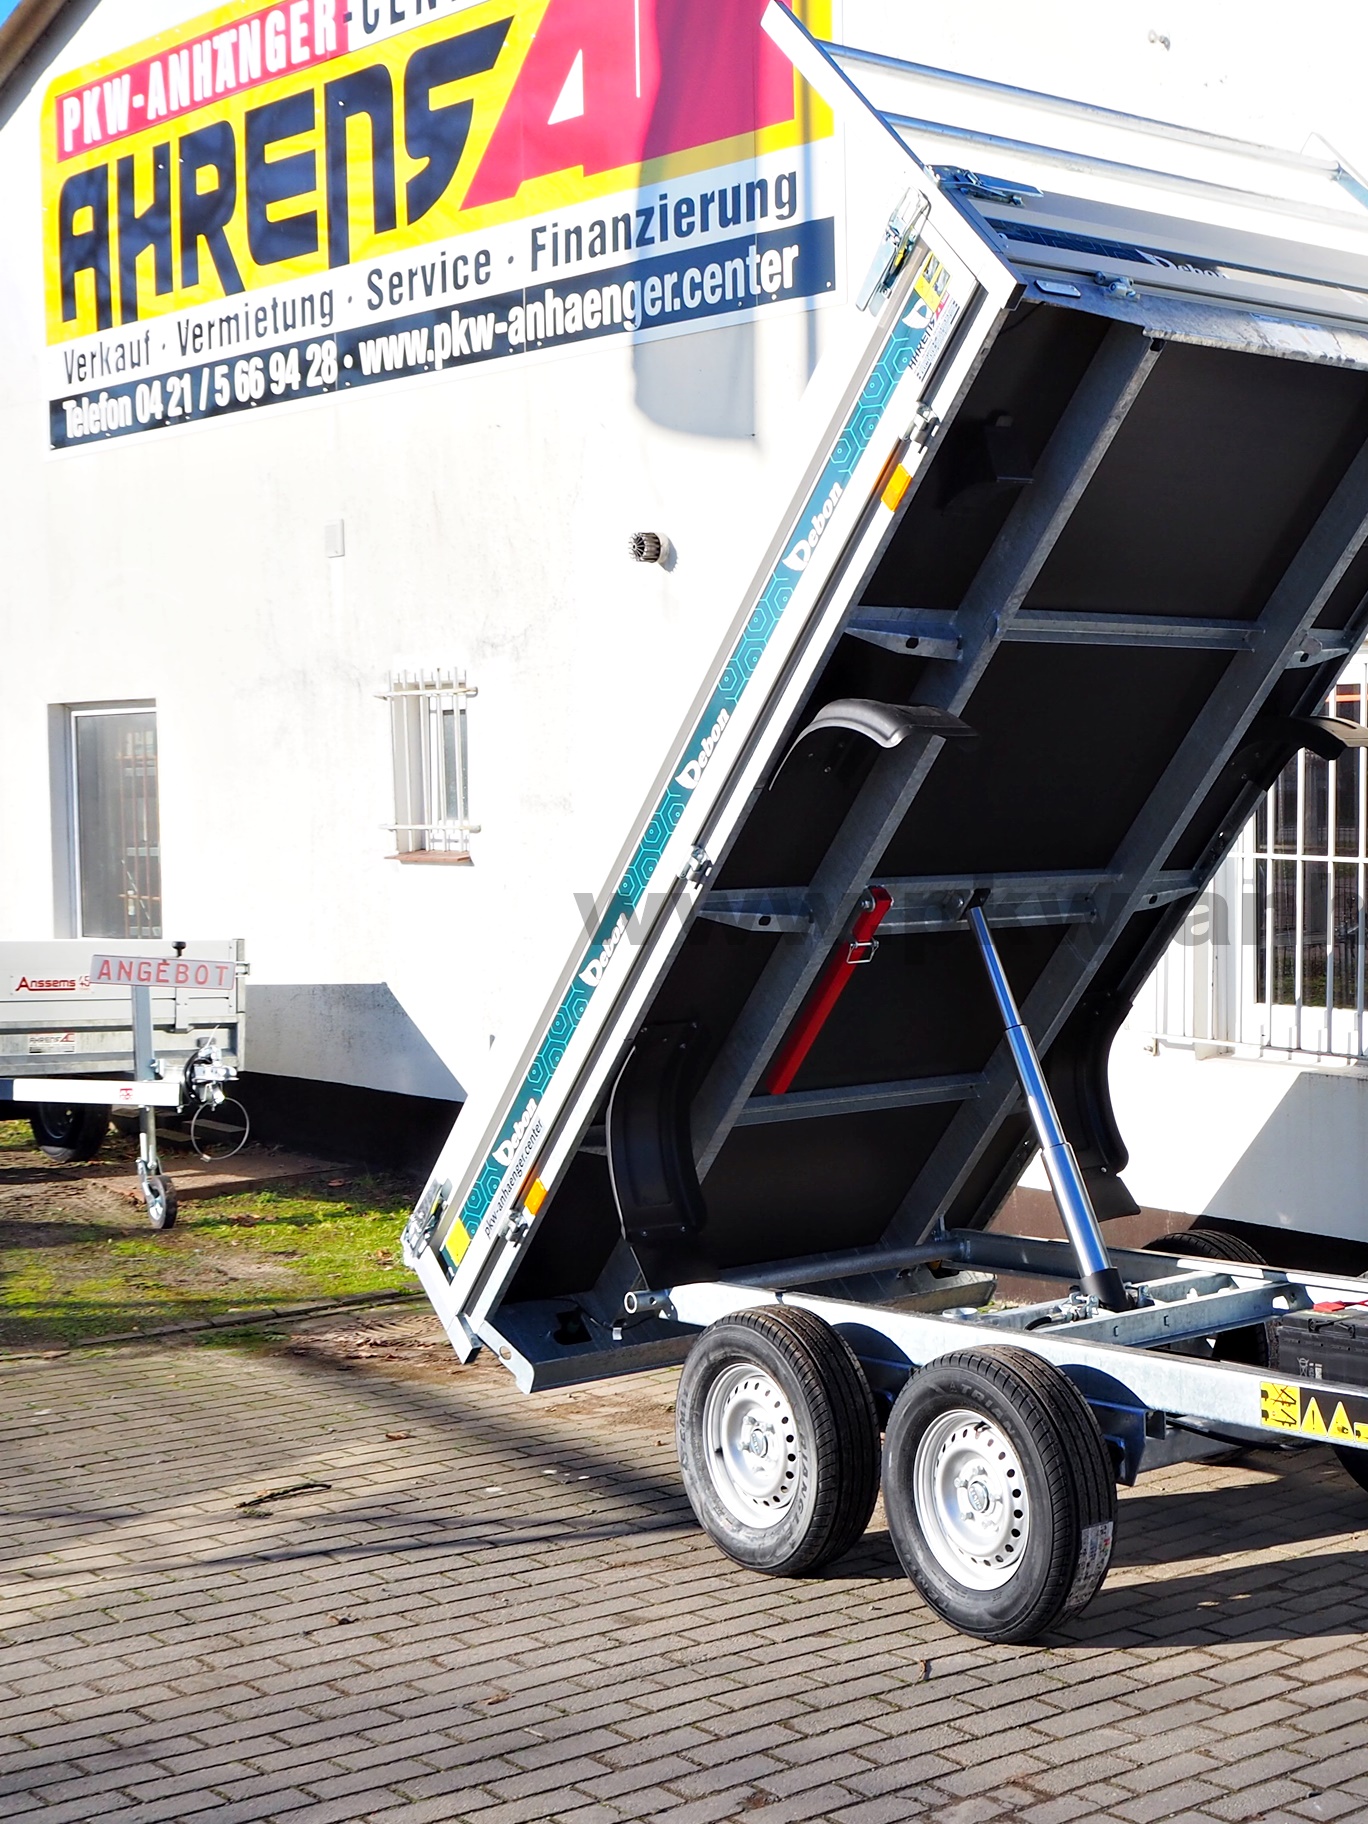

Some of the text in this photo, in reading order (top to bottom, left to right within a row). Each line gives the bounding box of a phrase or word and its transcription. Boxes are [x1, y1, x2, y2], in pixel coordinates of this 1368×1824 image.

[58, 15, 516, 331] AHRENS
[64, 170, 797, 385] Verkauf Vermietung Service Finanzierung
[62, 391, 132, 438] Telefon
[359, 242, 799, 376] www.pkw-anhaenger.center
[782, 482, 843, 571] Debon
[675, 708, 730, 789] Debon
[15, 976, 76, 992] Anssems
[97, 959, 229, 987] ANGEBOT
[578, 912, 629, 987] Debon
[493, 1098, 538, 1166] Debon
[484, 1119, 545, 1239] pkw-anhaenger.center
